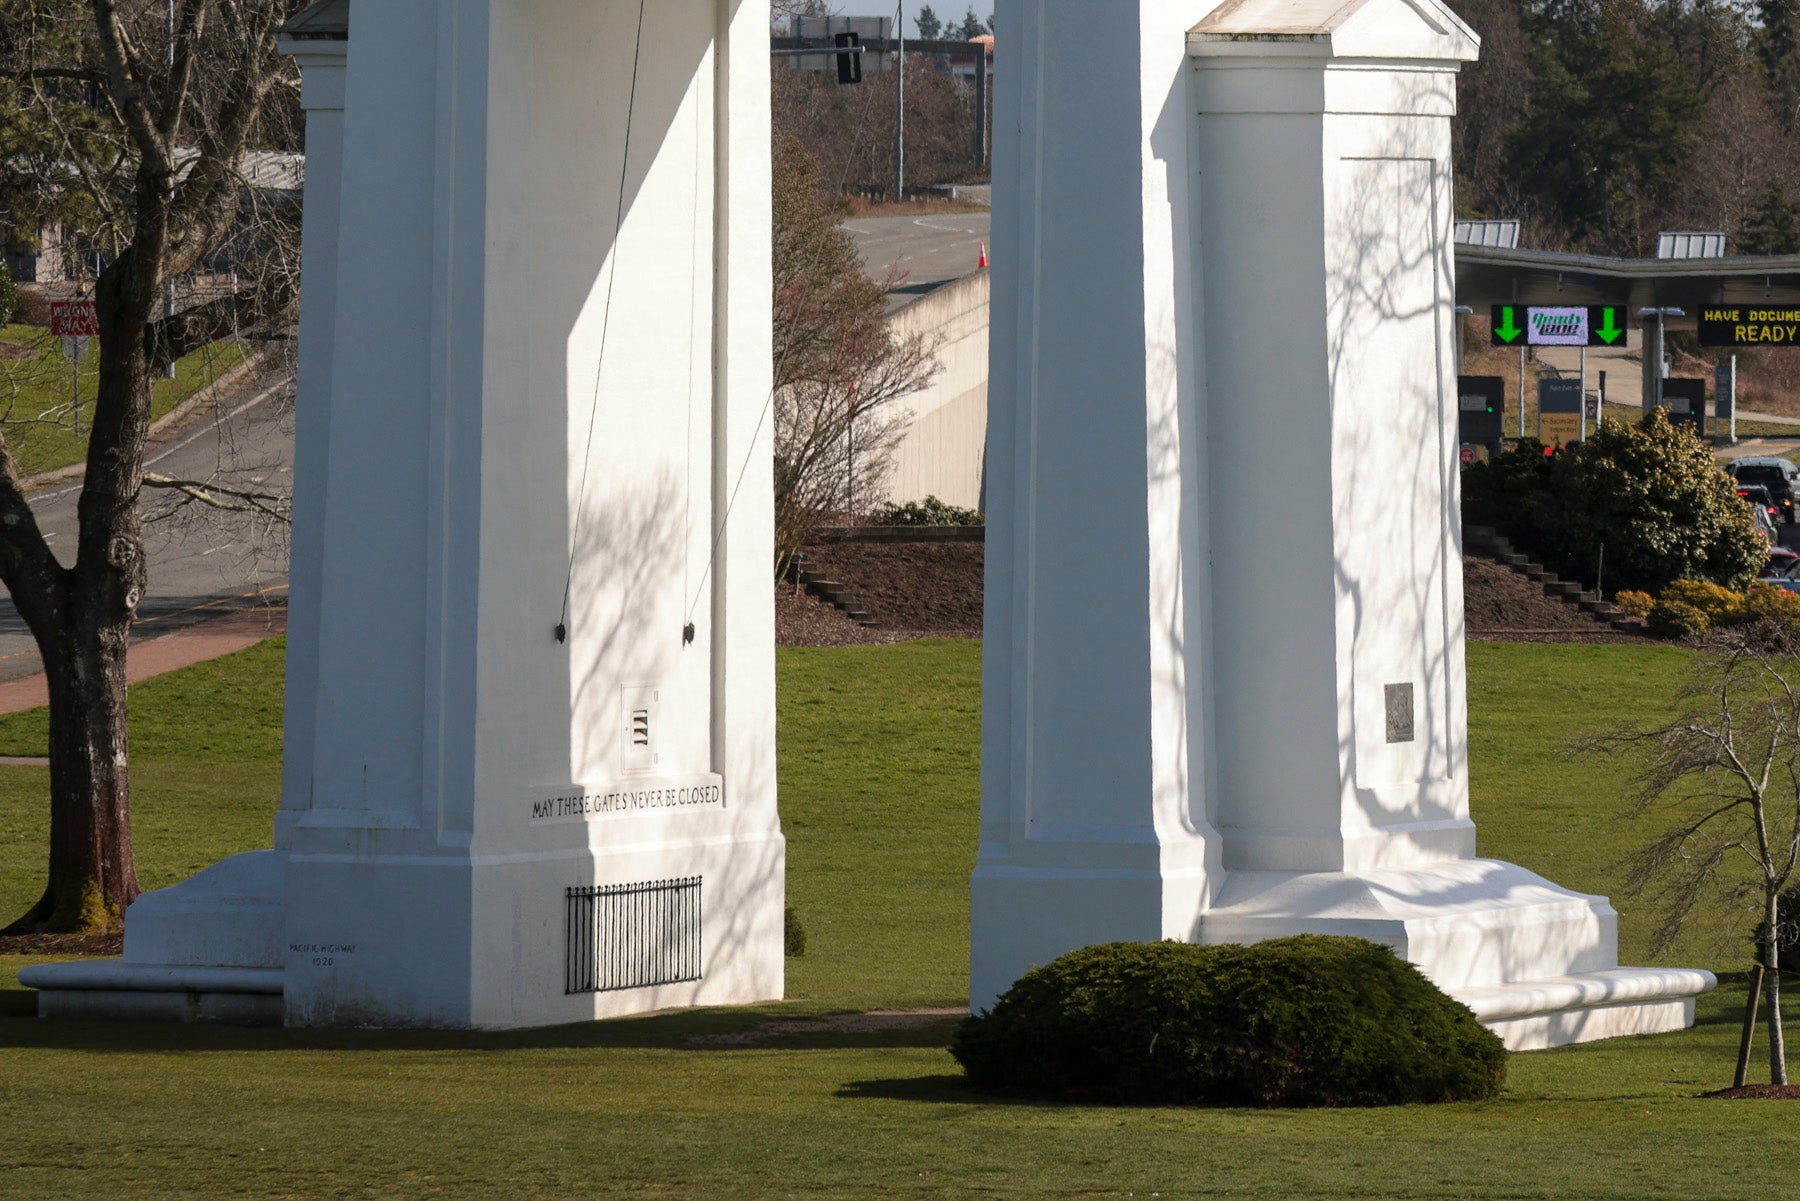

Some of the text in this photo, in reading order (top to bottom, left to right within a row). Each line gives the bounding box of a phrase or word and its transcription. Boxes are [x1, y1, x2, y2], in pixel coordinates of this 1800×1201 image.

[1704, 310, 1740, 321] HAVE
[1735, 325, 1797, 341] READY
[533, 785, 719, 818] MAY THESE GATES NEVER BE CLOSED
